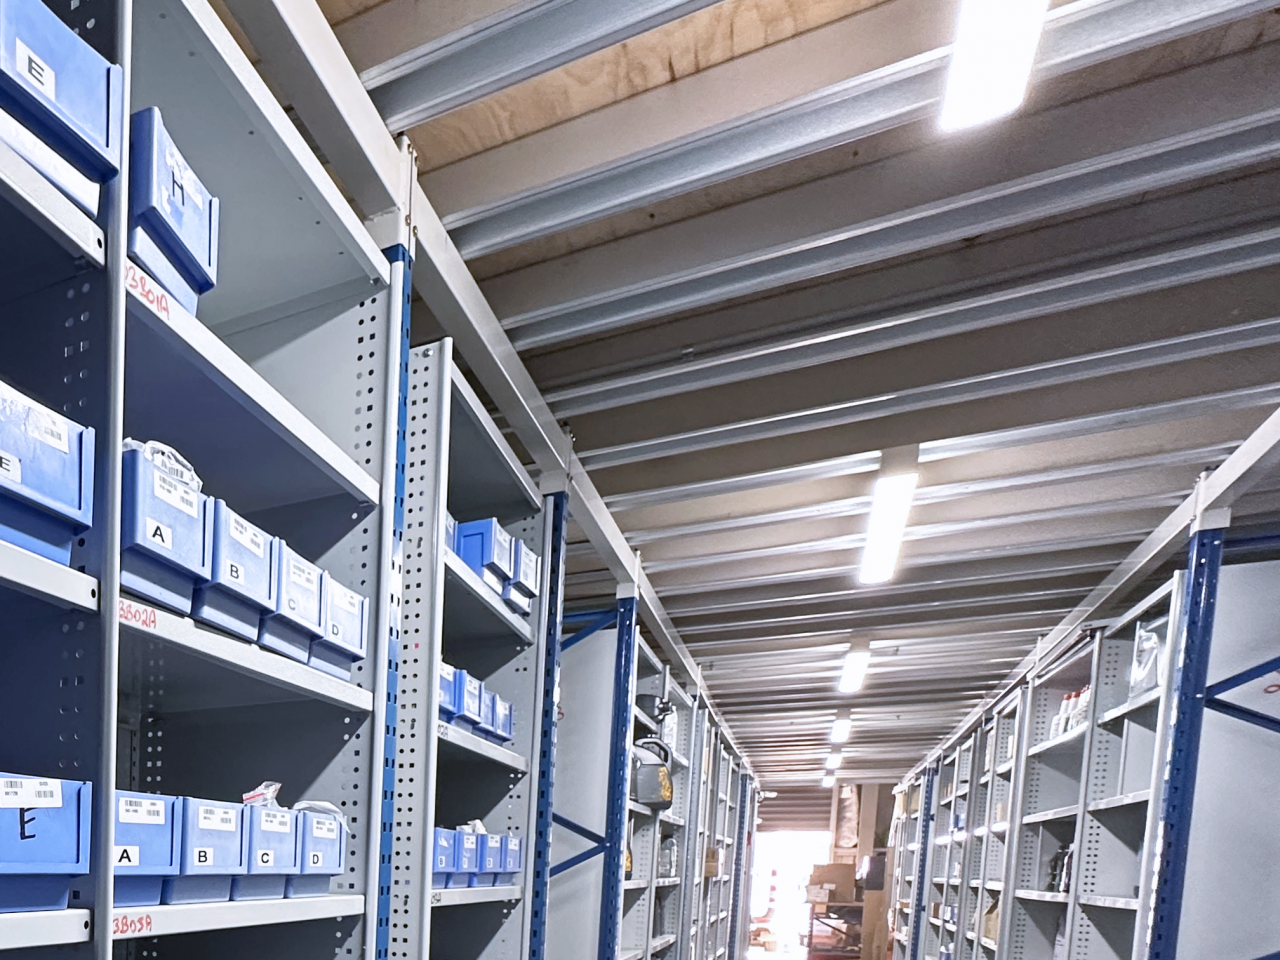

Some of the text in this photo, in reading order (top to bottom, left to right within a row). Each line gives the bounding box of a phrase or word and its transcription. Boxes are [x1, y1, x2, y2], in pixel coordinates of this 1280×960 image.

[28, 55, 45, 86] E
[0, 456, 11, 472] E
[152, 525, 165, 543] A
[230, 564, 239, 580] B
[288, 599, 297, 611] C
[331, 623, 339, 636] D
[19, 807, 37, 840] E
[118, 849, 132, 863] A
[197, 850, 208, 863] B
[260, 852, 270, 864] C
[312, 853, 320, 865] D
